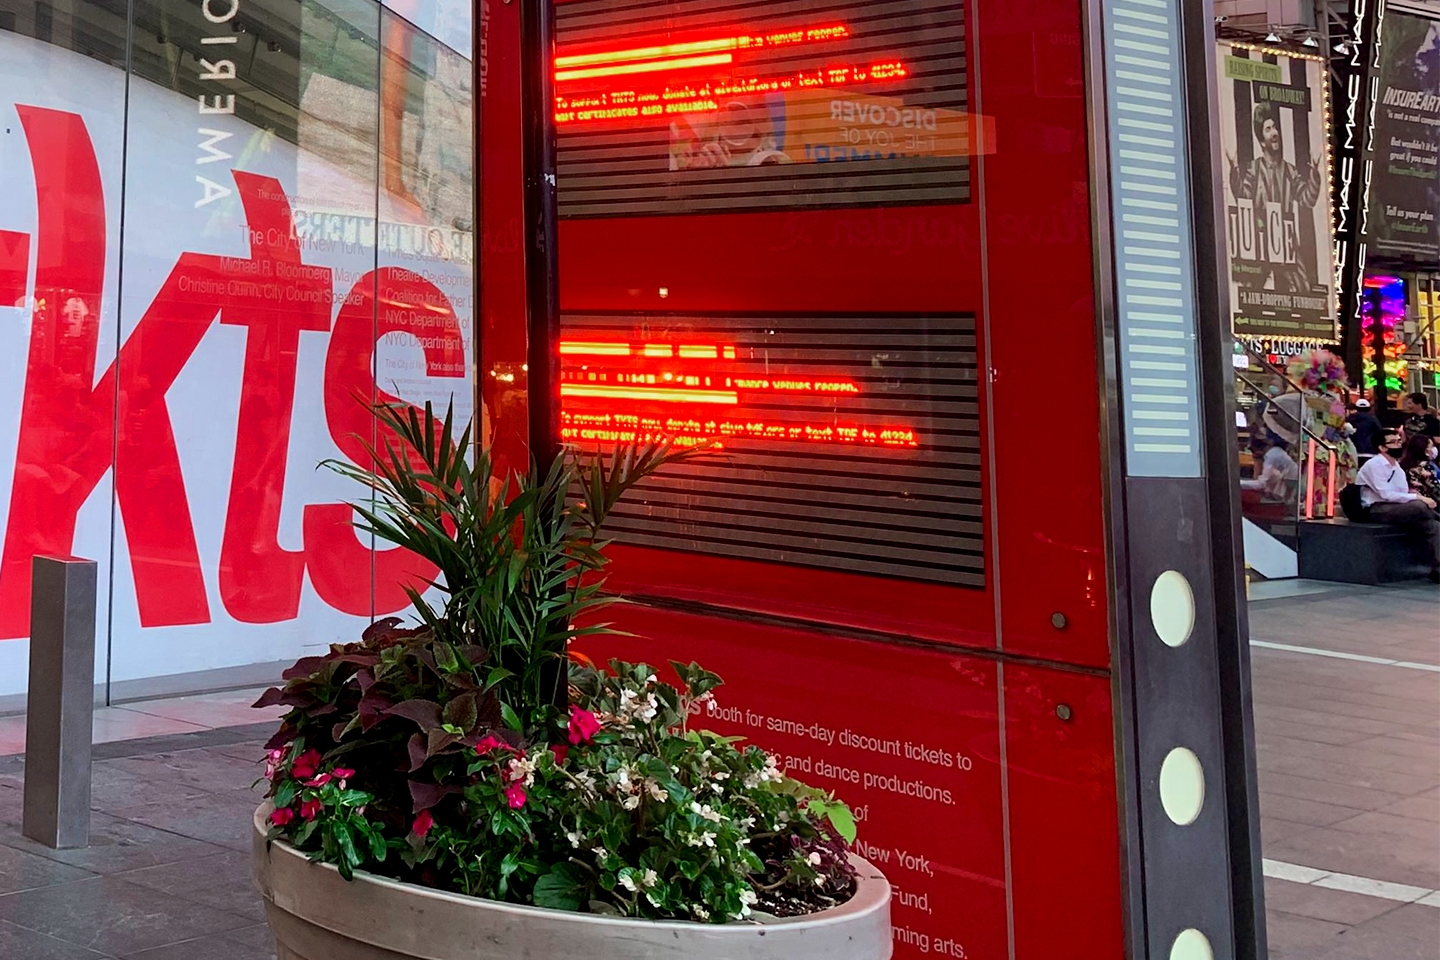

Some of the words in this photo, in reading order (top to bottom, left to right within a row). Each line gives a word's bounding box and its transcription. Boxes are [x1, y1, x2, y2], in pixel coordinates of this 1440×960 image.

[238, 224, 264, 245] The
[266, 228, 294, 253] City
[295, 231, 307, 250] of
[220, 257, 260, 275] Michael
[263, 260, 274, 275] R.
[178, 275, 224, 294] Christine
[263, 284, 284, 303] City
[286, 286, 323, 303] Council
[324, 288, 365, 306] Speaker
[385, 309, 407, 326] NYC
[409, 311, 461, 330] Department
[385, 332, 407, 346] NYC
[409, 333, 461, 351] Department
[706, 706, 742, 724] booth
[746, 709, 764, 727] for
[766, 716, 836, 746] same-day
[839, 729, 901, 757] discount
[904, 742, 953, 768] tickets
[956, 752, 973, 771] to
[785, 755, 811, 773] and
[815, 759, 860, 784] dance
[864, 772, 957, 806] productions.
[854, 805, 869, 821] of
[856, 839, 890, 863] New
[895, 848, 934, 877] York,
[891, 885, 933, 915] Fund,
[934, 936, 968, 959] arts.
